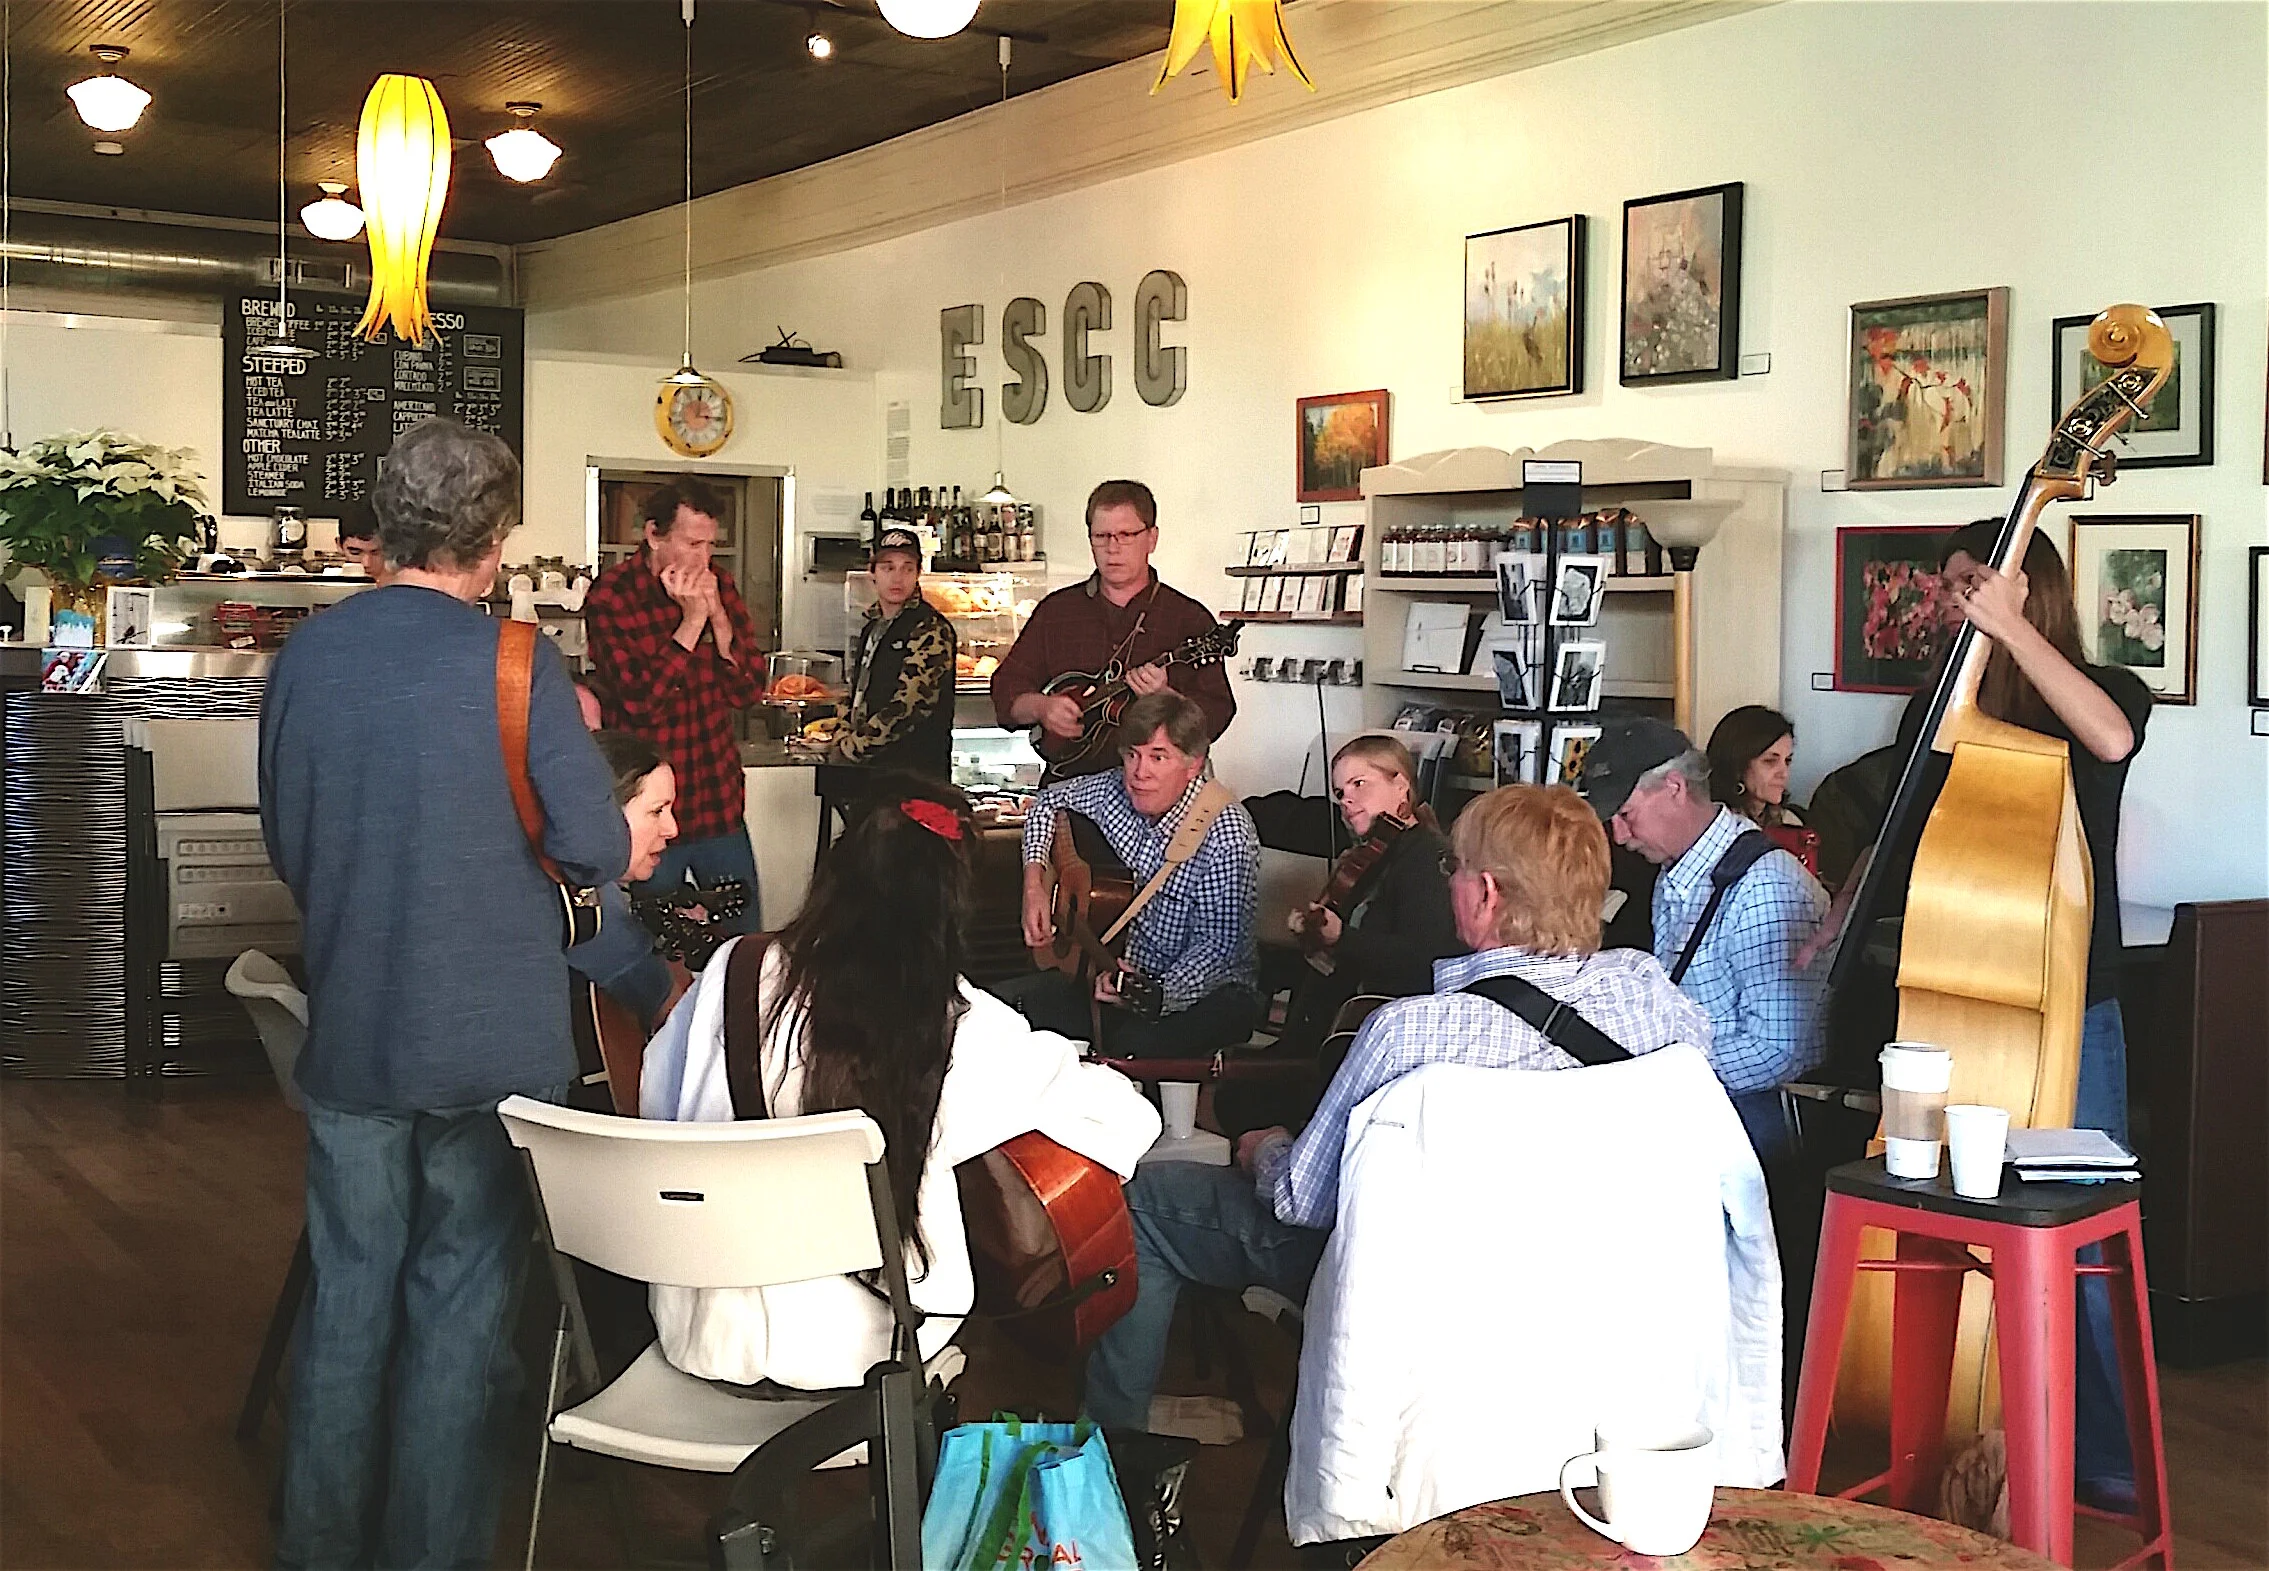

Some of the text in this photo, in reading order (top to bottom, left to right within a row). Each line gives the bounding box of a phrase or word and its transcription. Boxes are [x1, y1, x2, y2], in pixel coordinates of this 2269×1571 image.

[241, 299, 296, 318] BREWD
[940, 268, 1188, 430] ESCC
[242, 356, 307, 375] STEEPED
[393, 370, 427, 381] CORTADO
[245, 376, 283, 388] HOT TEA
[246, 386, 286, 398] ICED TEA
[246, 396, 263, 408] TEA
[246, 406, 294, 418] TEA LATTE
[246, 417, 294, 429] SANCTUARY
[296, 419, 319, 430] CHAI
[246, 428, 280, 439] MATCHA
[242, 438, 281, 454] OTHER
[247, 452, 309, 465] HOT CHOCOLATE
[247, 461, 299, 473] APPLE CIDER
[247, 470, 285, 481] STEAMER
[247, 479, 305, 490] ITALIAN SODA
